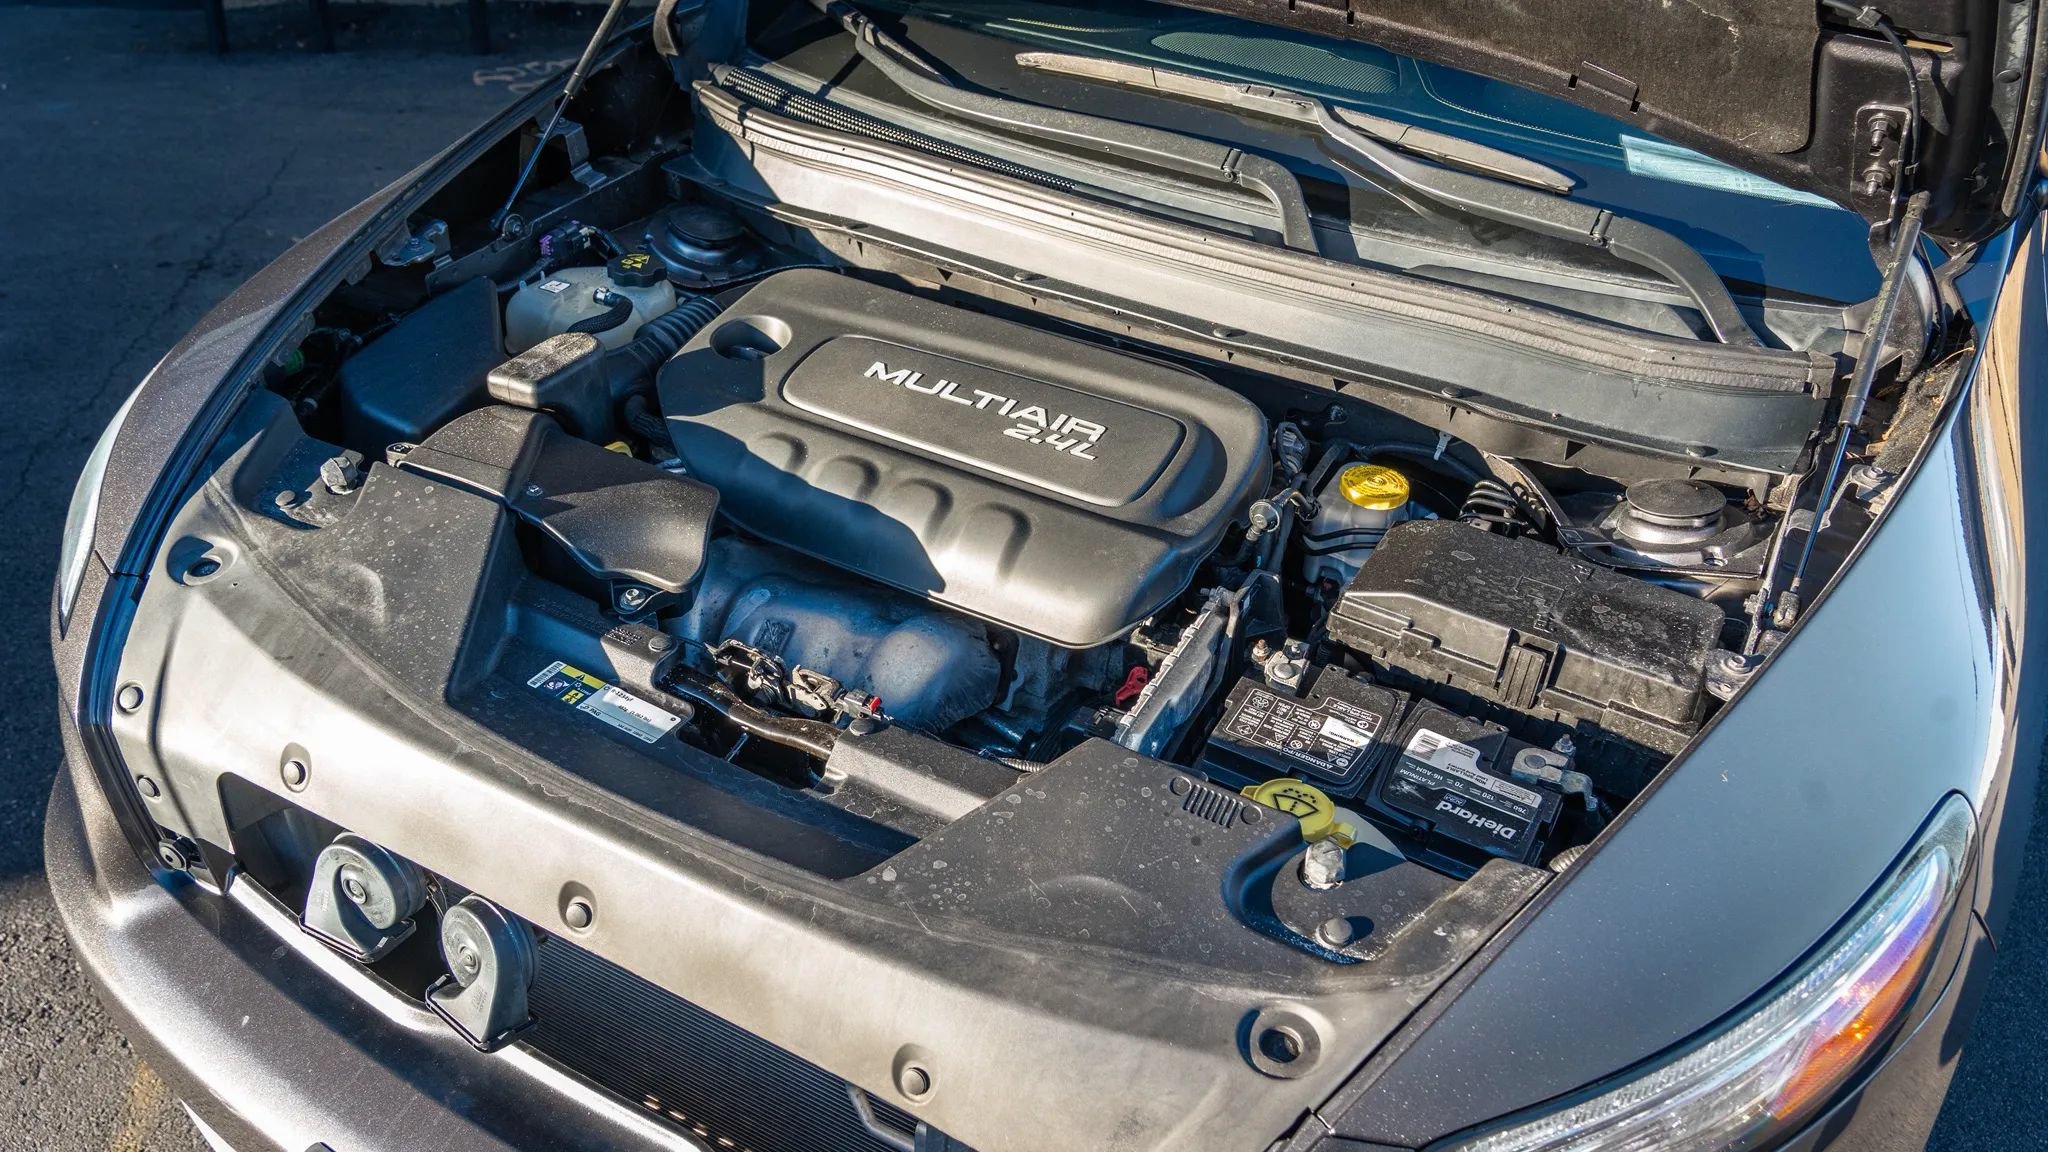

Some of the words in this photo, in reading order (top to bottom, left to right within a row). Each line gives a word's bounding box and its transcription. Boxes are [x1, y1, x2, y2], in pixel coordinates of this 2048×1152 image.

[864, 361, 1108, 443] MULTIAIR
[1003, 422, 1098, 460] 2.4L
[588, 708, 601, 716] PAG
[1328, 730, 1354, 742] WARNING:
[1264, 739, 1327, 767] DANGER/POSON
[1399, 768, 1435, 786] PLATINUM
[1453, 780, 1464, 788] 70
[1480, 791, 1494, 801] 120
[1512, 804, 1526, 814] 760
[1434, 799, 1516, 839] DieHard
